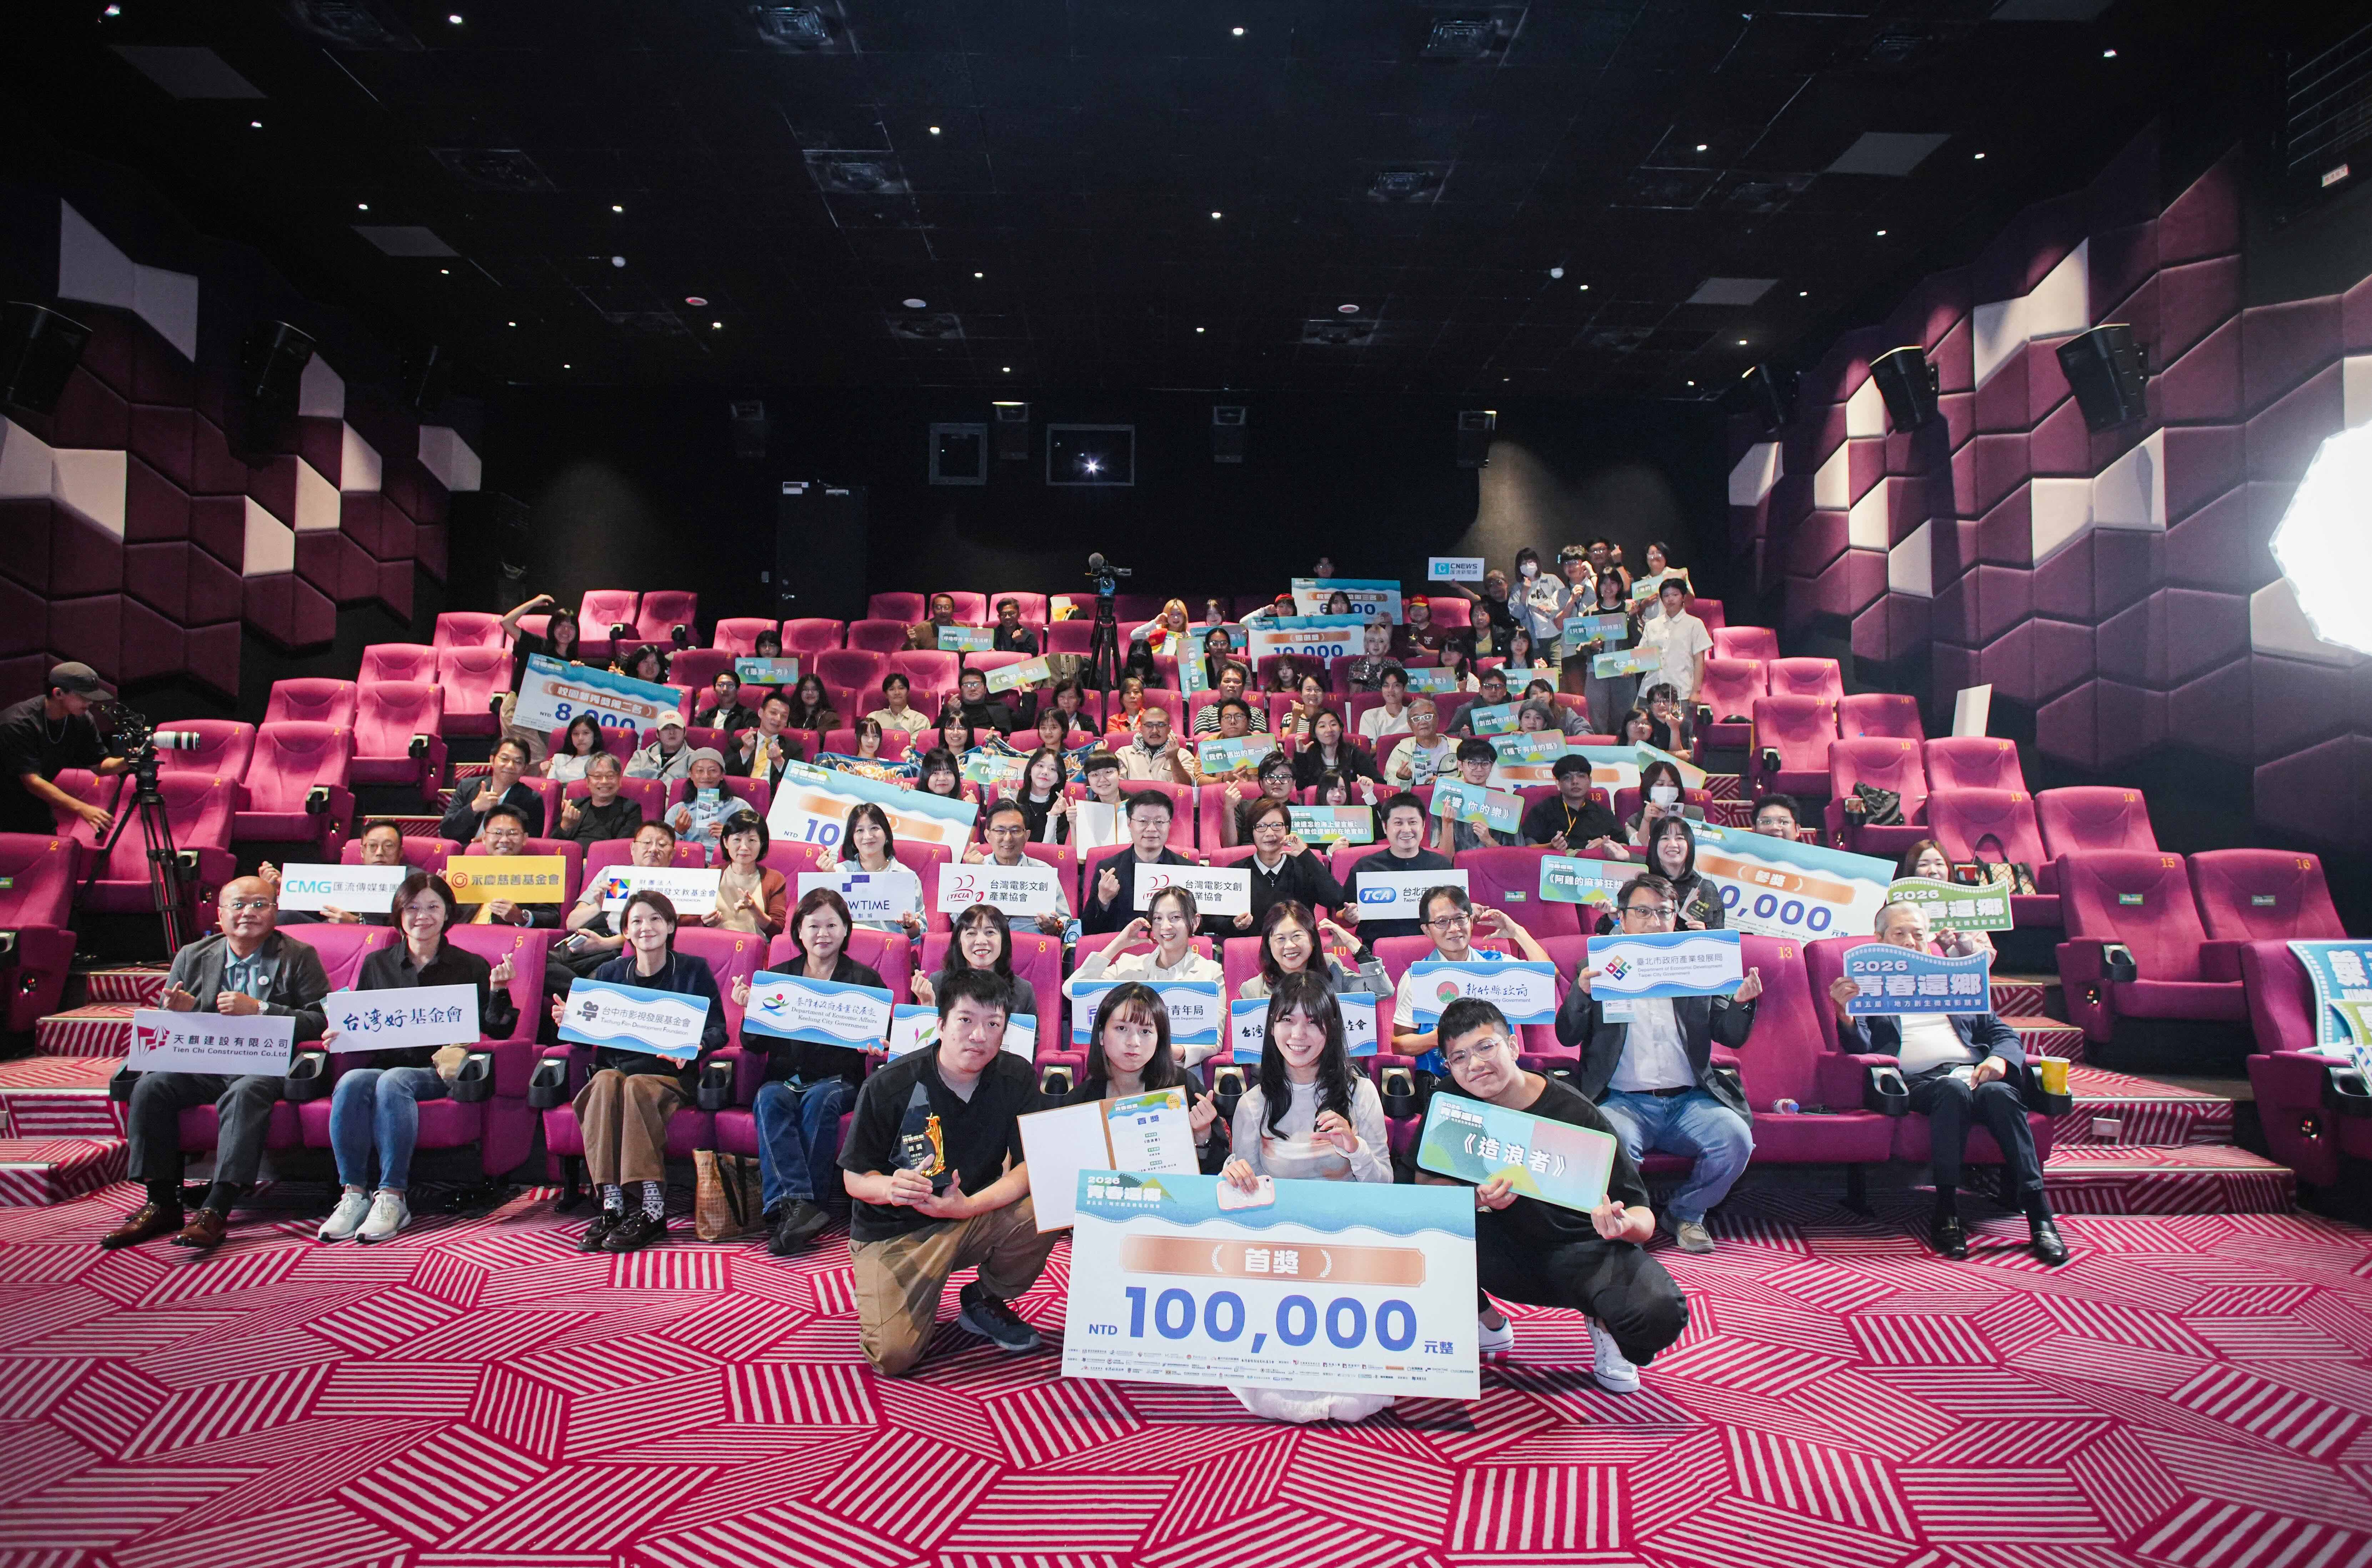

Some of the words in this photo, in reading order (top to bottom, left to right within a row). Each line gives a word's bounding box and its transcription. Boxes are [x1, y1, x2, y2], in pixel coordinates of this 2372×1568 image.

[1319, 603, 1375, 614] 600
[1274, 644, 1343, 657] 10000
[556, 702, 636, 729] 8000
[94, 777, 99, 785] 1
[540, 782, 546, 791] 3
[1468, 800, 1510, 819] 你的樂》
[50, 841, 58, 850] 2
[434, 844, 441, 853] 3
[555, 846, 561, 855] 4
[682, 847, 687, 856] 5
[806, 848, 812, 857] 6
[932, 849, 938, 858] 7
[1058, 851, 1064, 859] 8
[2162, 858, 2174, 868] 15
[2296, 859, 2310, 869] 16
[471, 874, 560, 885] 永慶慈善基金會
[1755, 869, 1786, 888] 參獎
[286, 880, 332, 893] CMG
[333, 881, 399, 893] 匯流傳媒集團
[991, 879, 1048, 891] 台灣電影文創
[1185, 879, 1242, 891] 台灣電影文創
[989, 891, 1028, 902] 產業協會
[1194, 892, 1223, 902] 業協會
[1364, 890, 1391, 901] TCA
[1892, 890, 1940, 900] 2026
[848, 900, 890, 910] WTIME
[1719, 884, 1831, 932] 0,000
[1921, 898, 2004, 919] 春還鄉
[366, 933, 373, 944] 4
[515, 936, 523, 948] 5
[736, 940, 743, 951] 6
[886, 939, 893, 950] 7
[1039, 941, 1045, 952] 8
[1192, 944, 1199, 953] 9
[1334, 947, 1346, 956] 10
[1777, 947, 1792, 958] 13
[1636, 953, 1723, 966] 臺北市政府產業發展局
[1852, 960, 1908, 972] 2026
[1465, 982, 1529, 997] 新竹縣政府
[1854, 973, 1982, 997] 青春還鄉
[1854, 999, 1882, 1007] 第五屆
[1894, 999, 1982, 1007] 地方創生微電影競賽
[602, 1006, 691, 1027] 台中市影視發展基金會
[791, 1006, 824, 1016] Department
[832, 1012, 858, 1021] Economic
[858, 1016, 877, 1024] Affairs
[798, 1015, 821, 1024] Keelung
[822, 1018, 833, 1026] City
[835, 1019, 868, 1030] Government
[632, 1022, 662, 1032] Development
[663, 1027, 688, 1036] Foundation
[208, 1047, 258, 1056] Construction
[1464, 1132, 1566, 1177] 《造浪者》
[1087, 1176, 1120, 1185] 2026
[1087, 1185, 1162, 1202] 青春還鄉
[1245, 1248, 1299, 1275] 首獎
[1088, 1323, 1118, 1336] NTD
[1125, 1286, 1417, 1354] 100,000
[1424, 1340, 1454, 1355] 元整
